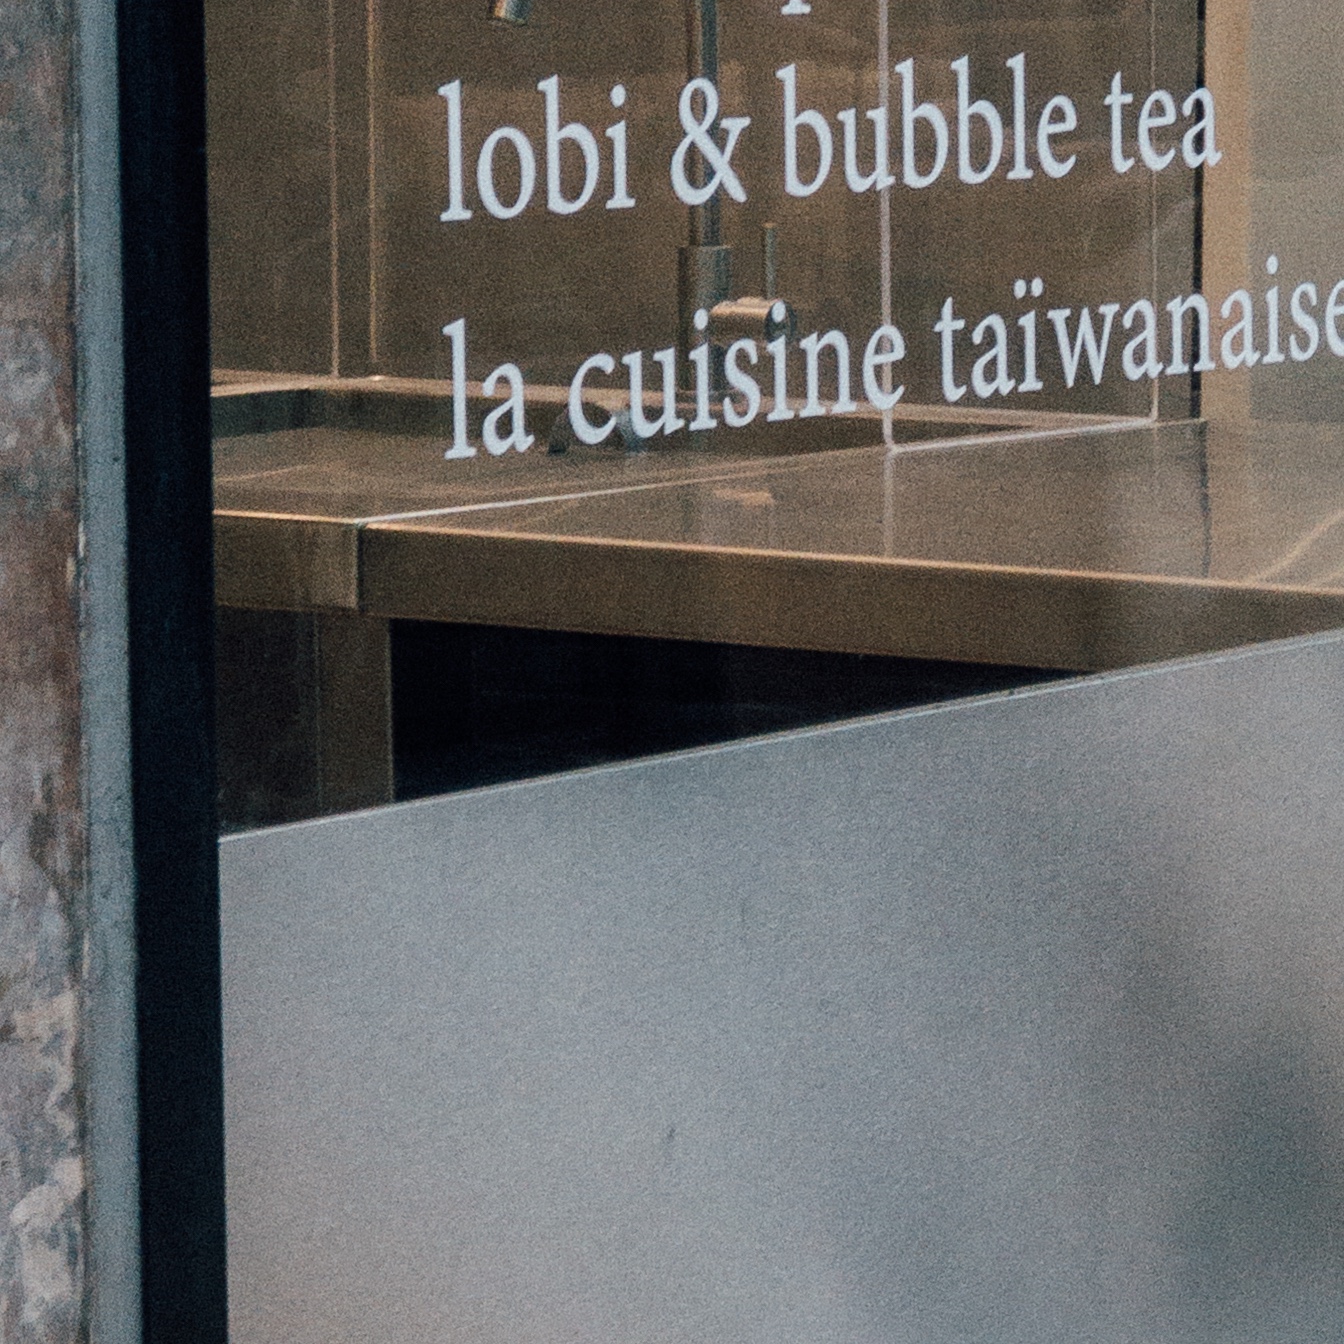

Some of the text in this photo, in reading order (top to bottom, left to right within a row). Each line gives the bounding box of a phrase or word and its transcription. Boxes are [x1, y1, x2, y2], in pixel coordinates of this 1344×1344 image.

[437, 53, 1222, 222] lobi & bubble tea
[441, 318, 532, 459] la
[567, 300, 907, 446] cuisine
